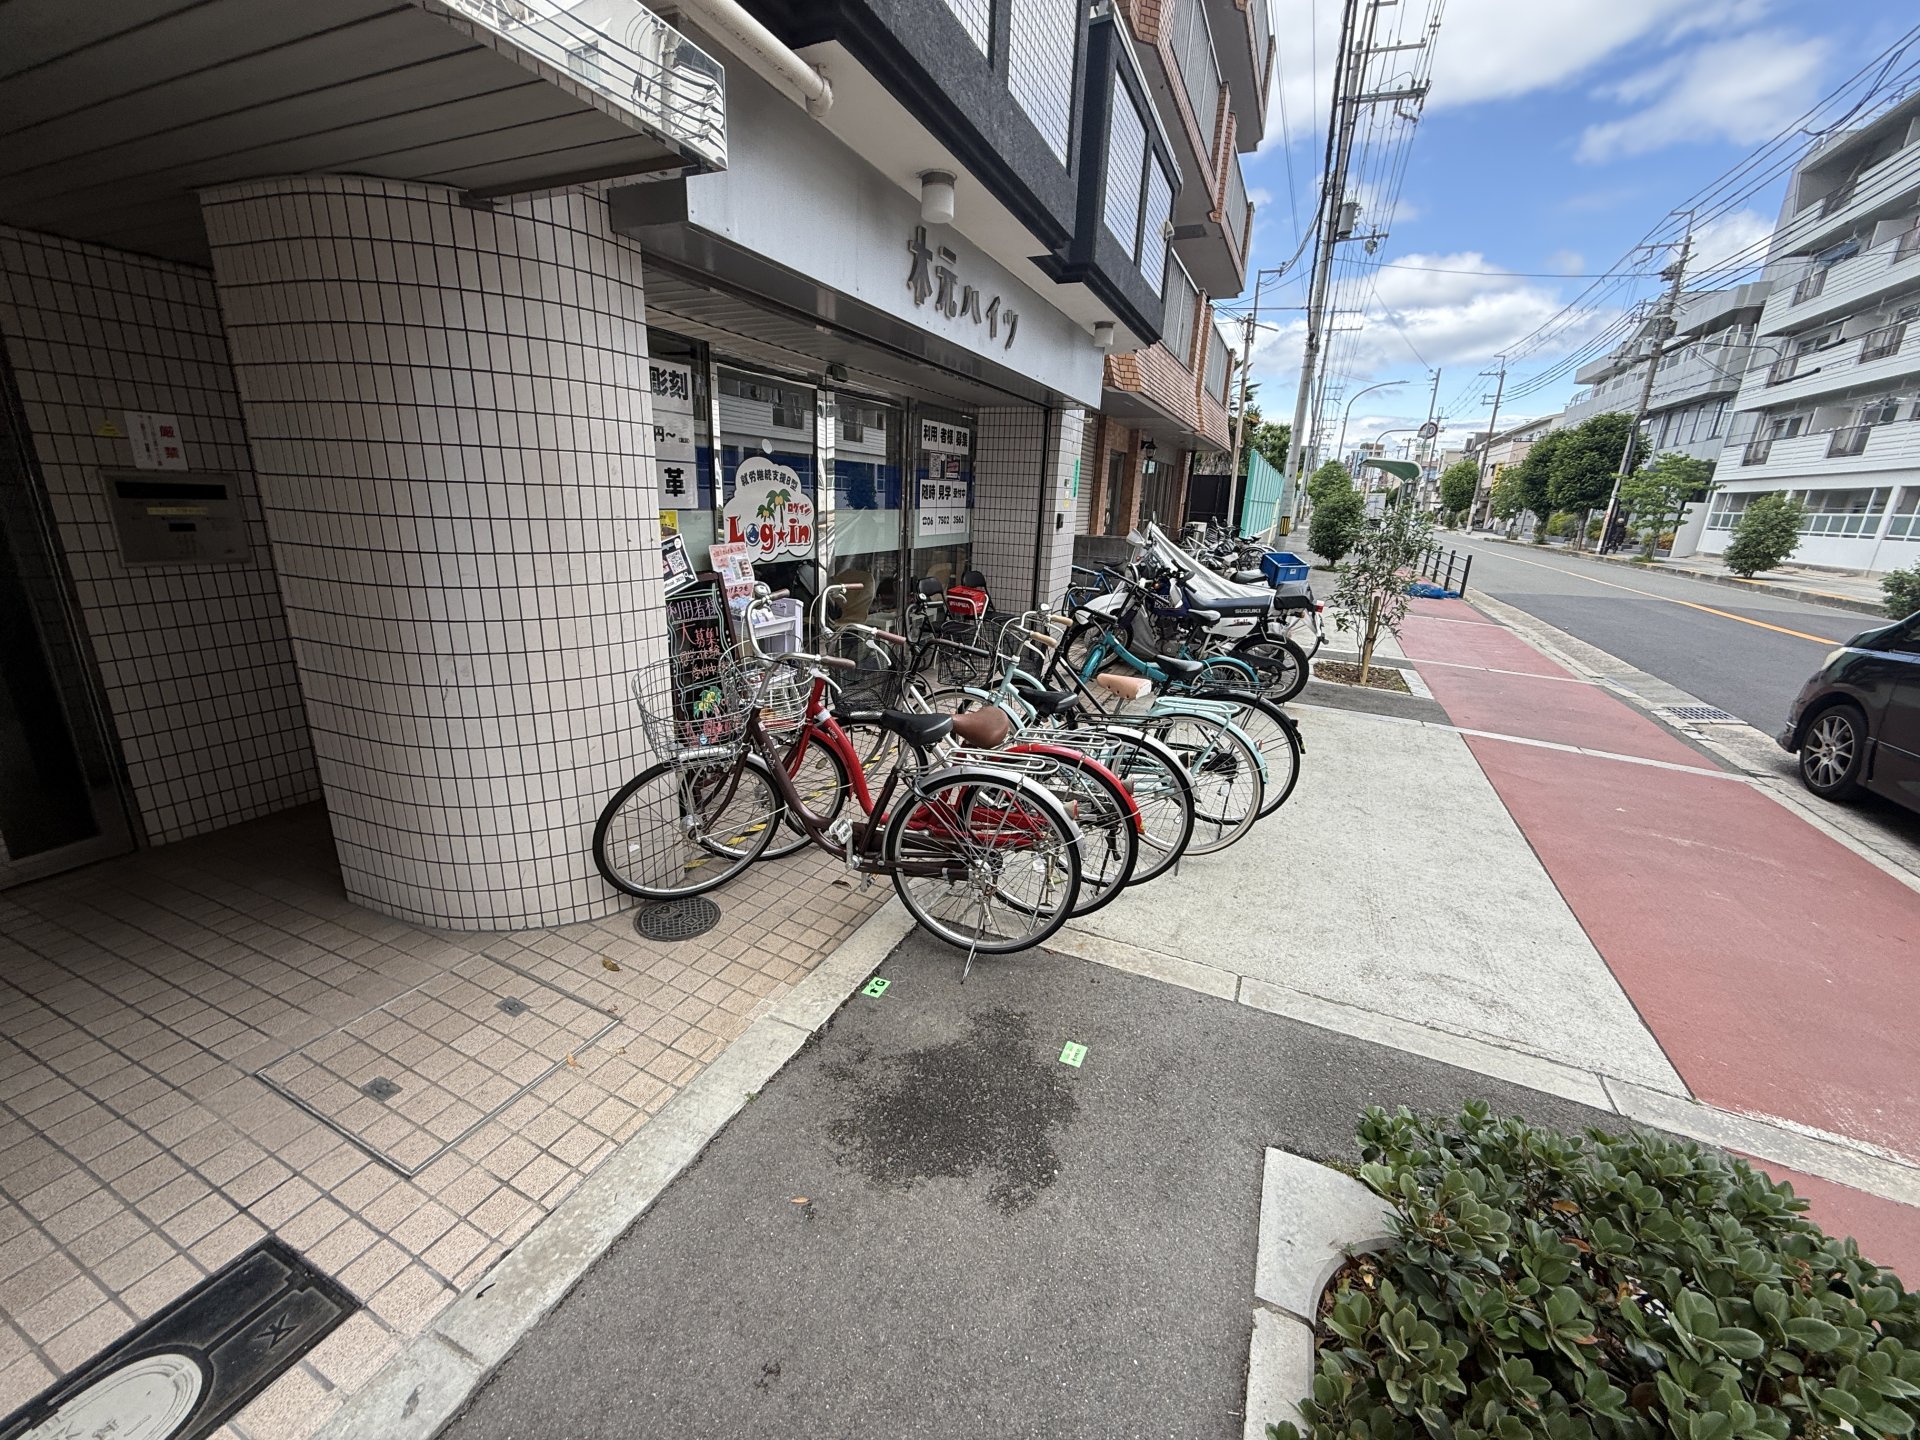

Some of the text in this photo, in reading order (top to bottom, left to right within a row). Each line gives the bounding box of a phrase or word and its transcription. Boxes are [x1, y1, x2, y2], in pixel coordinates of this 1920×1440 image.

[664, 467, 685, 497] 革
[787, 502, 812, 515] ログイン
